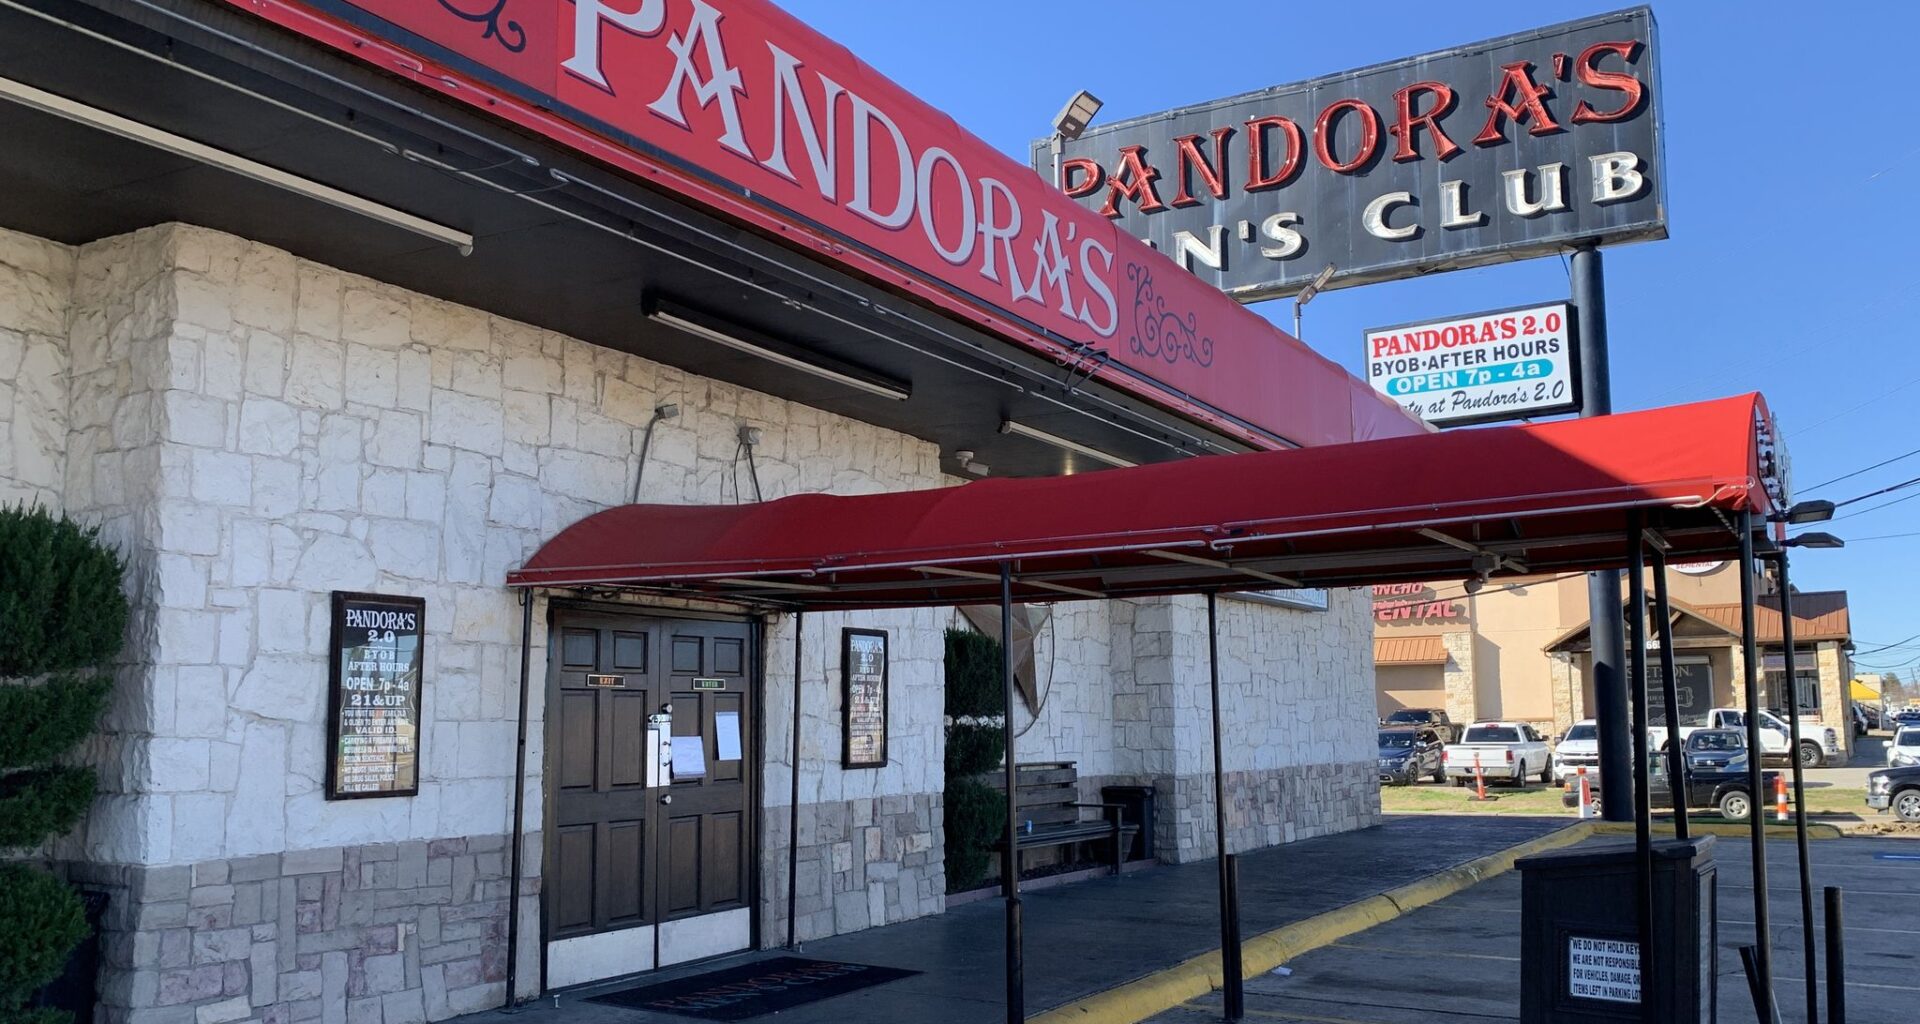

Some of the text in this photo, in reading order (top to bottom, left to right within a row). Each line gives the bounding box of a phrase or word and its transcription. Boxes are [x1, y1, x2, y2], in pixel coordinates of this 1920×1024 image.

[1061, 40, 1646, 219] PANDORA'S
[560, 0, 1119, 338] PANDORA'S
[1362, 151, 1645, 240] CLUB
[1372, 312, 1561, 358] PANDORA'S 2.0
[1493, 338, 1560, 361] HOURS
[1396, 371, 1458, 393] OPEN
[1465, 369, 1491, 385] 7p
[1511, 362, 1541, 378] 4a
[1428, 398, 1446, 413] at
[1451, 386, 1528, 411] Pandora's
[1533, 379, 1564, 400] 2.0
[346, 609, 416, 630] PANDORA'S
[1372, 600, 1457, 621] ENTAL
[367, 629, 395, 643] 2.0
[348, 661, 409, 672] AFTER HOURS
[346, 676, 374, 690] OPEN
[378, 677, 390, 693] 7p
[397, 678, 409, 690] 4a
[599, 677, 615, 685] EXIT
[351, 694, 406, 706] 21&UP
[1573, 939, 1582, 950] WE
[1583, 940, 1591, 950] DO
[1593, 941, 1605, 952] NOT
[1607, 942, 1624, 953] HOLD
[1573, 954, 1580, 964] WE
[1582, 954, 1592, 965] ARE
[1593, 955, 1604, 967] NOT
[1573, 968, 1583, 979] FOR
[1573, 983, 1588, 993] ITEMS
[1589, 985, 1601, 995] LEFT
[1602, 986, 1608, 996] IN
[1608, 986, 1631, 999] PARKING
